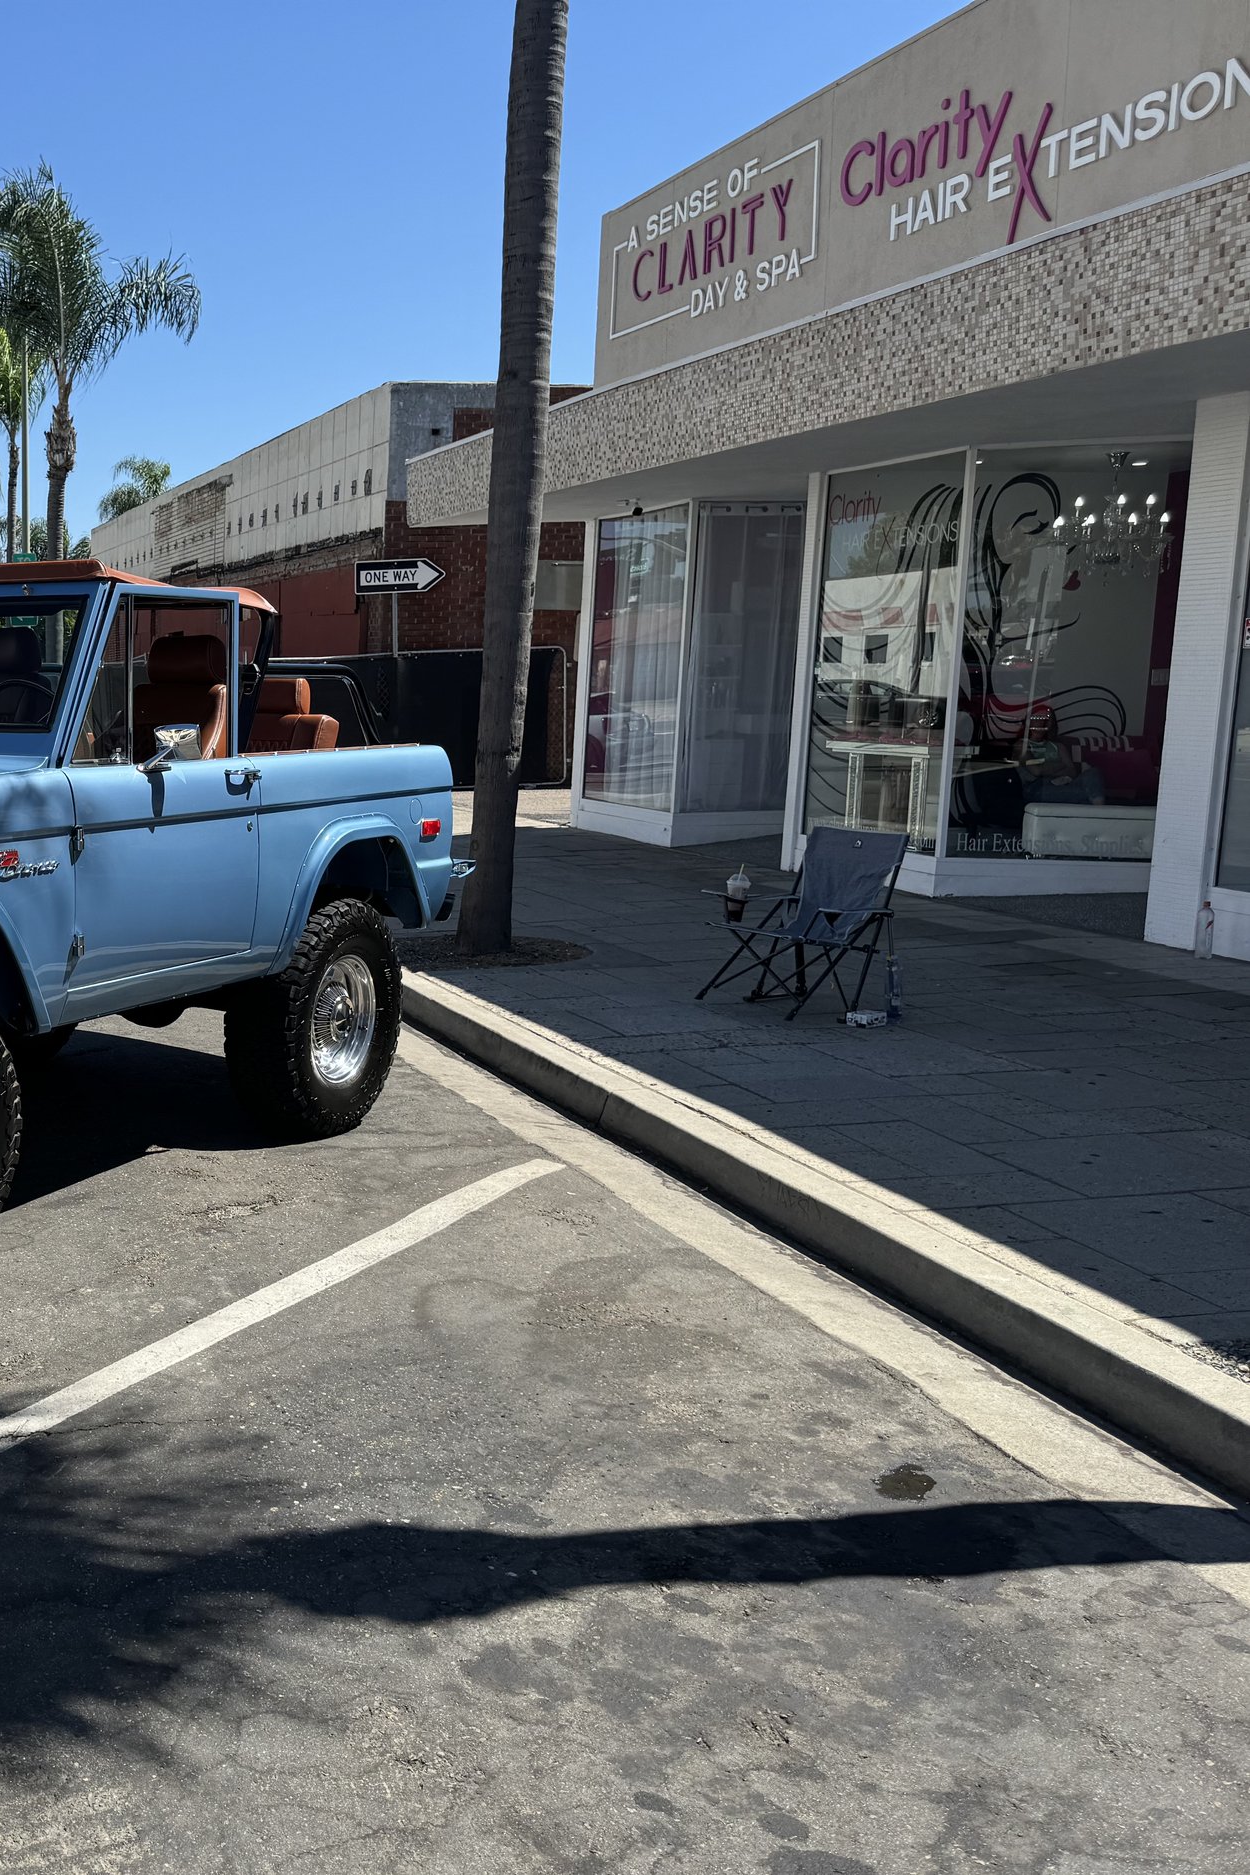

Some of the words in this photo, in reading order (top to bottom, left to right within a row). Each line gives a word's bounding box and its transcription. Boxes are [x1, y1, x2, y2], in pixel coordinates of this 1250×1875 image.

[840, 88, 1013, 207] Clarity
[627, 224, 640, 254] A
[646, 178, 720, 242] SENSE
[727, 157, 760, 199] OF
[632, 177, 794, 302] CLARITY
[889, 172, 974, 242] HAIR
[689, 275, 731, 319] DAY
[733, 268, 749, 302] &
[755, 247, 801, 293] SPA
[829, 490, 882, 530] Clarity
[842, 528, 870, 551] HAIR
[873, 515, 959, 572] EXTENSIONS
[364, 571, 389, 583] ONE
[393, 569, 418, 582] WAY
[956, 832, 989, 852] Hair
